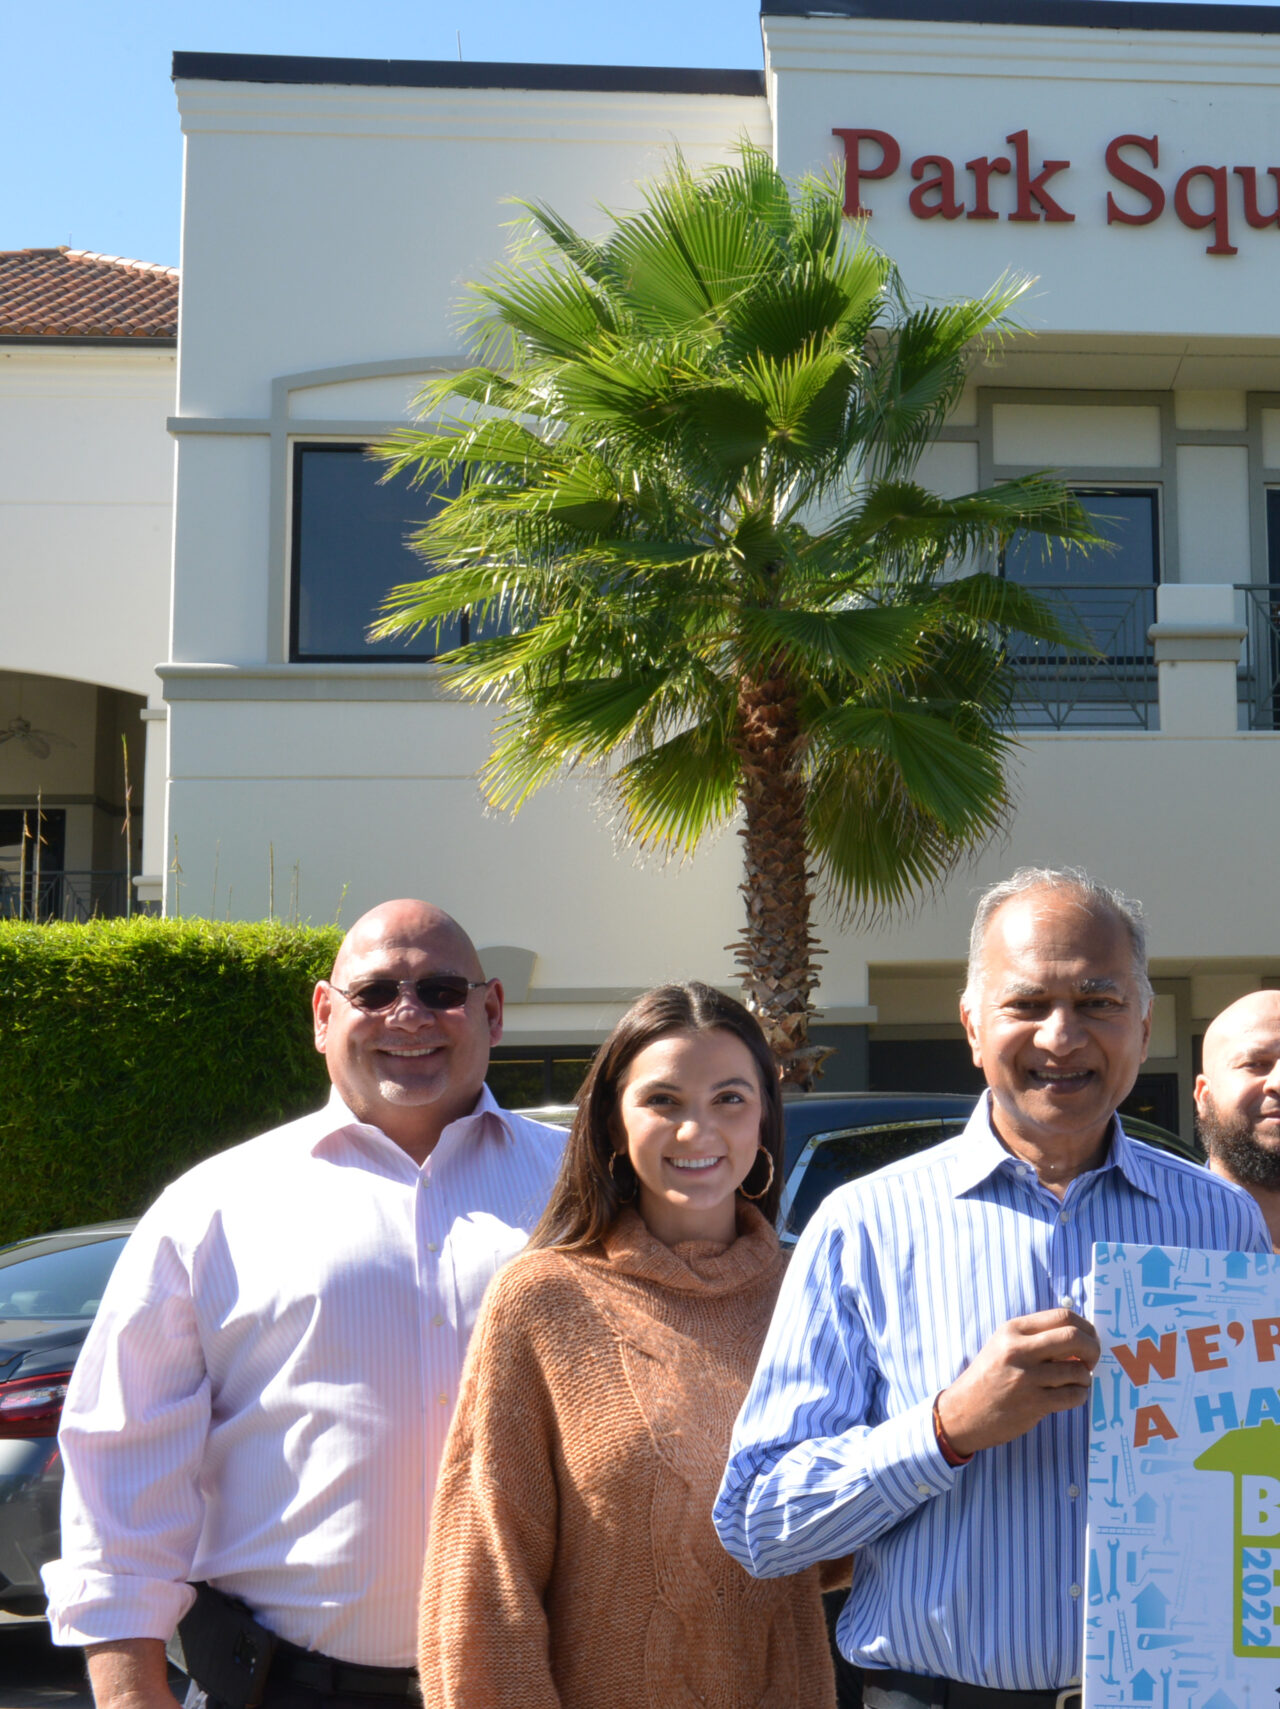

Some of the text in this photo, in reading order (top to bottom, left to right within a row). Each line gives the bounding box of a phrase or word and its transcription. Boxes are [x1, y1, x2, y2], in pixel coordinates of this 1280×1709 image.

[831, 127, 1076, 222] Park
[1131, 1404, 1179, 1448] A
[1242, 1547, 1272, 1647] 2022
